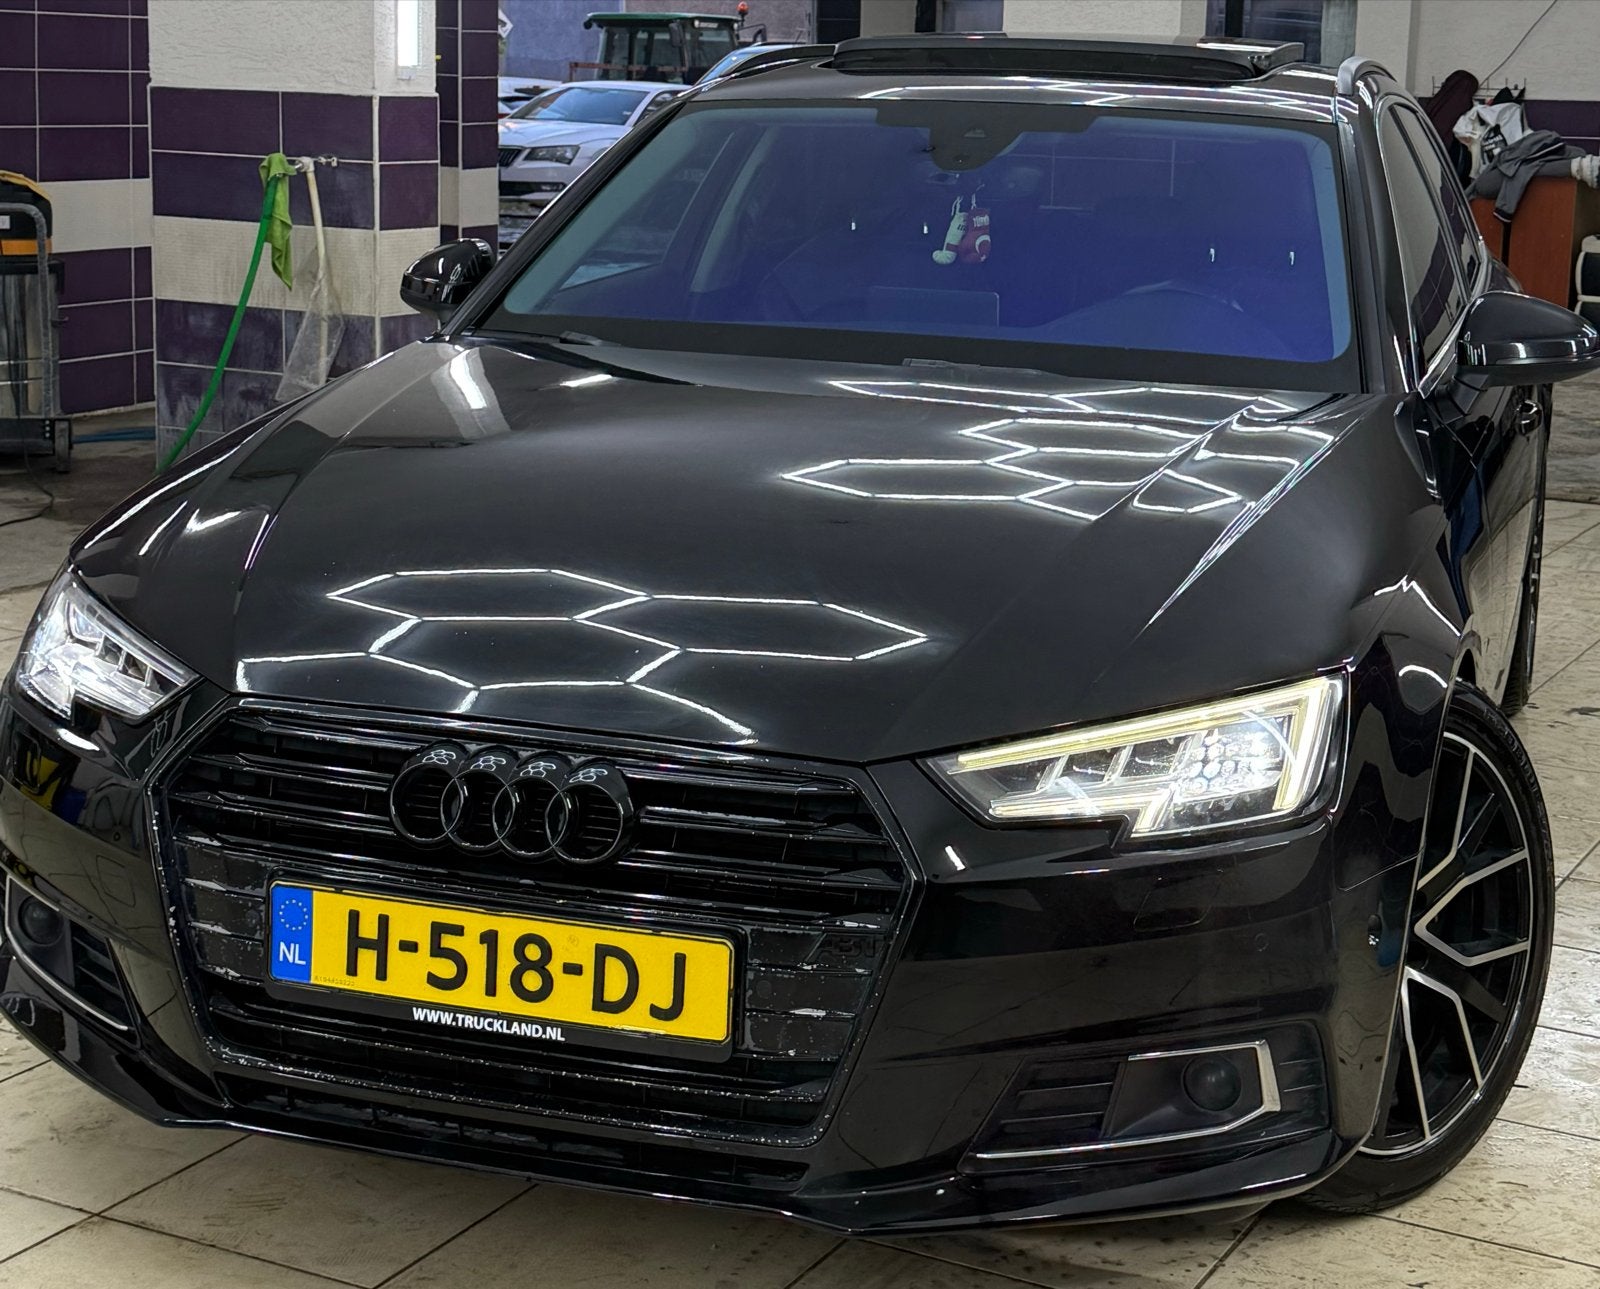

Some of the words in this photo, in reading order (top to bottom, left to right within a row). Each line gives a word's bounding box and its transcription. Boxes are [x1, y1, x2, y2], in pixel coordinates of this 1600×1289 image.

[279, 941, 307, 965] NL
[346, 909, 687, 1022] H-518-DJ
[412, 1007, 566, 1042] WWW.TRUCKLAND.NL
